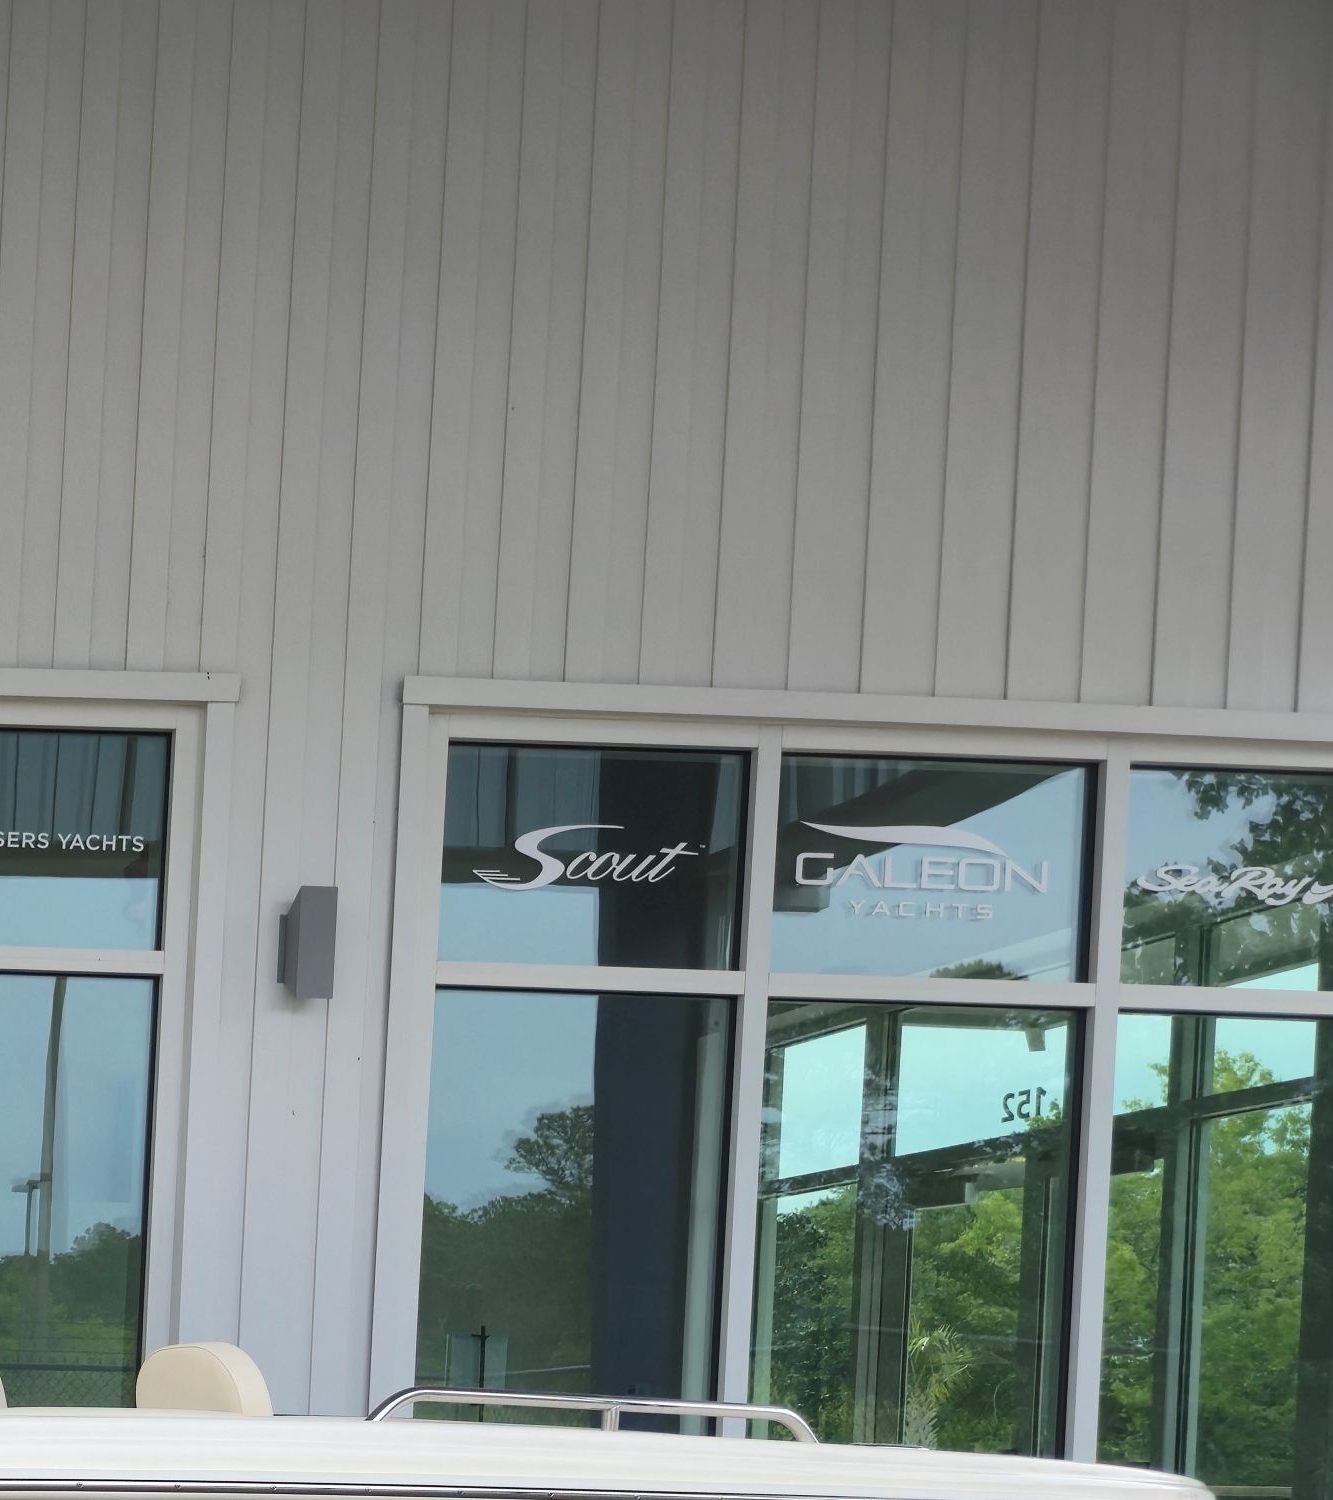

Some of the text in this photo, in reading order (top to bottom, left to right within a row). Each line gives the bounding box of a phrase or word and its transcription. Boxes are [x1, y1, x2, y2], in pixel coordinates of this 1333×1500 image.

[57, 833, 145, 853] YACHTS
[472, 824, 699, 890] Scout
[795, 852, 1048, 895] GALEON
[847, 900, 993, 919] YACHTS
